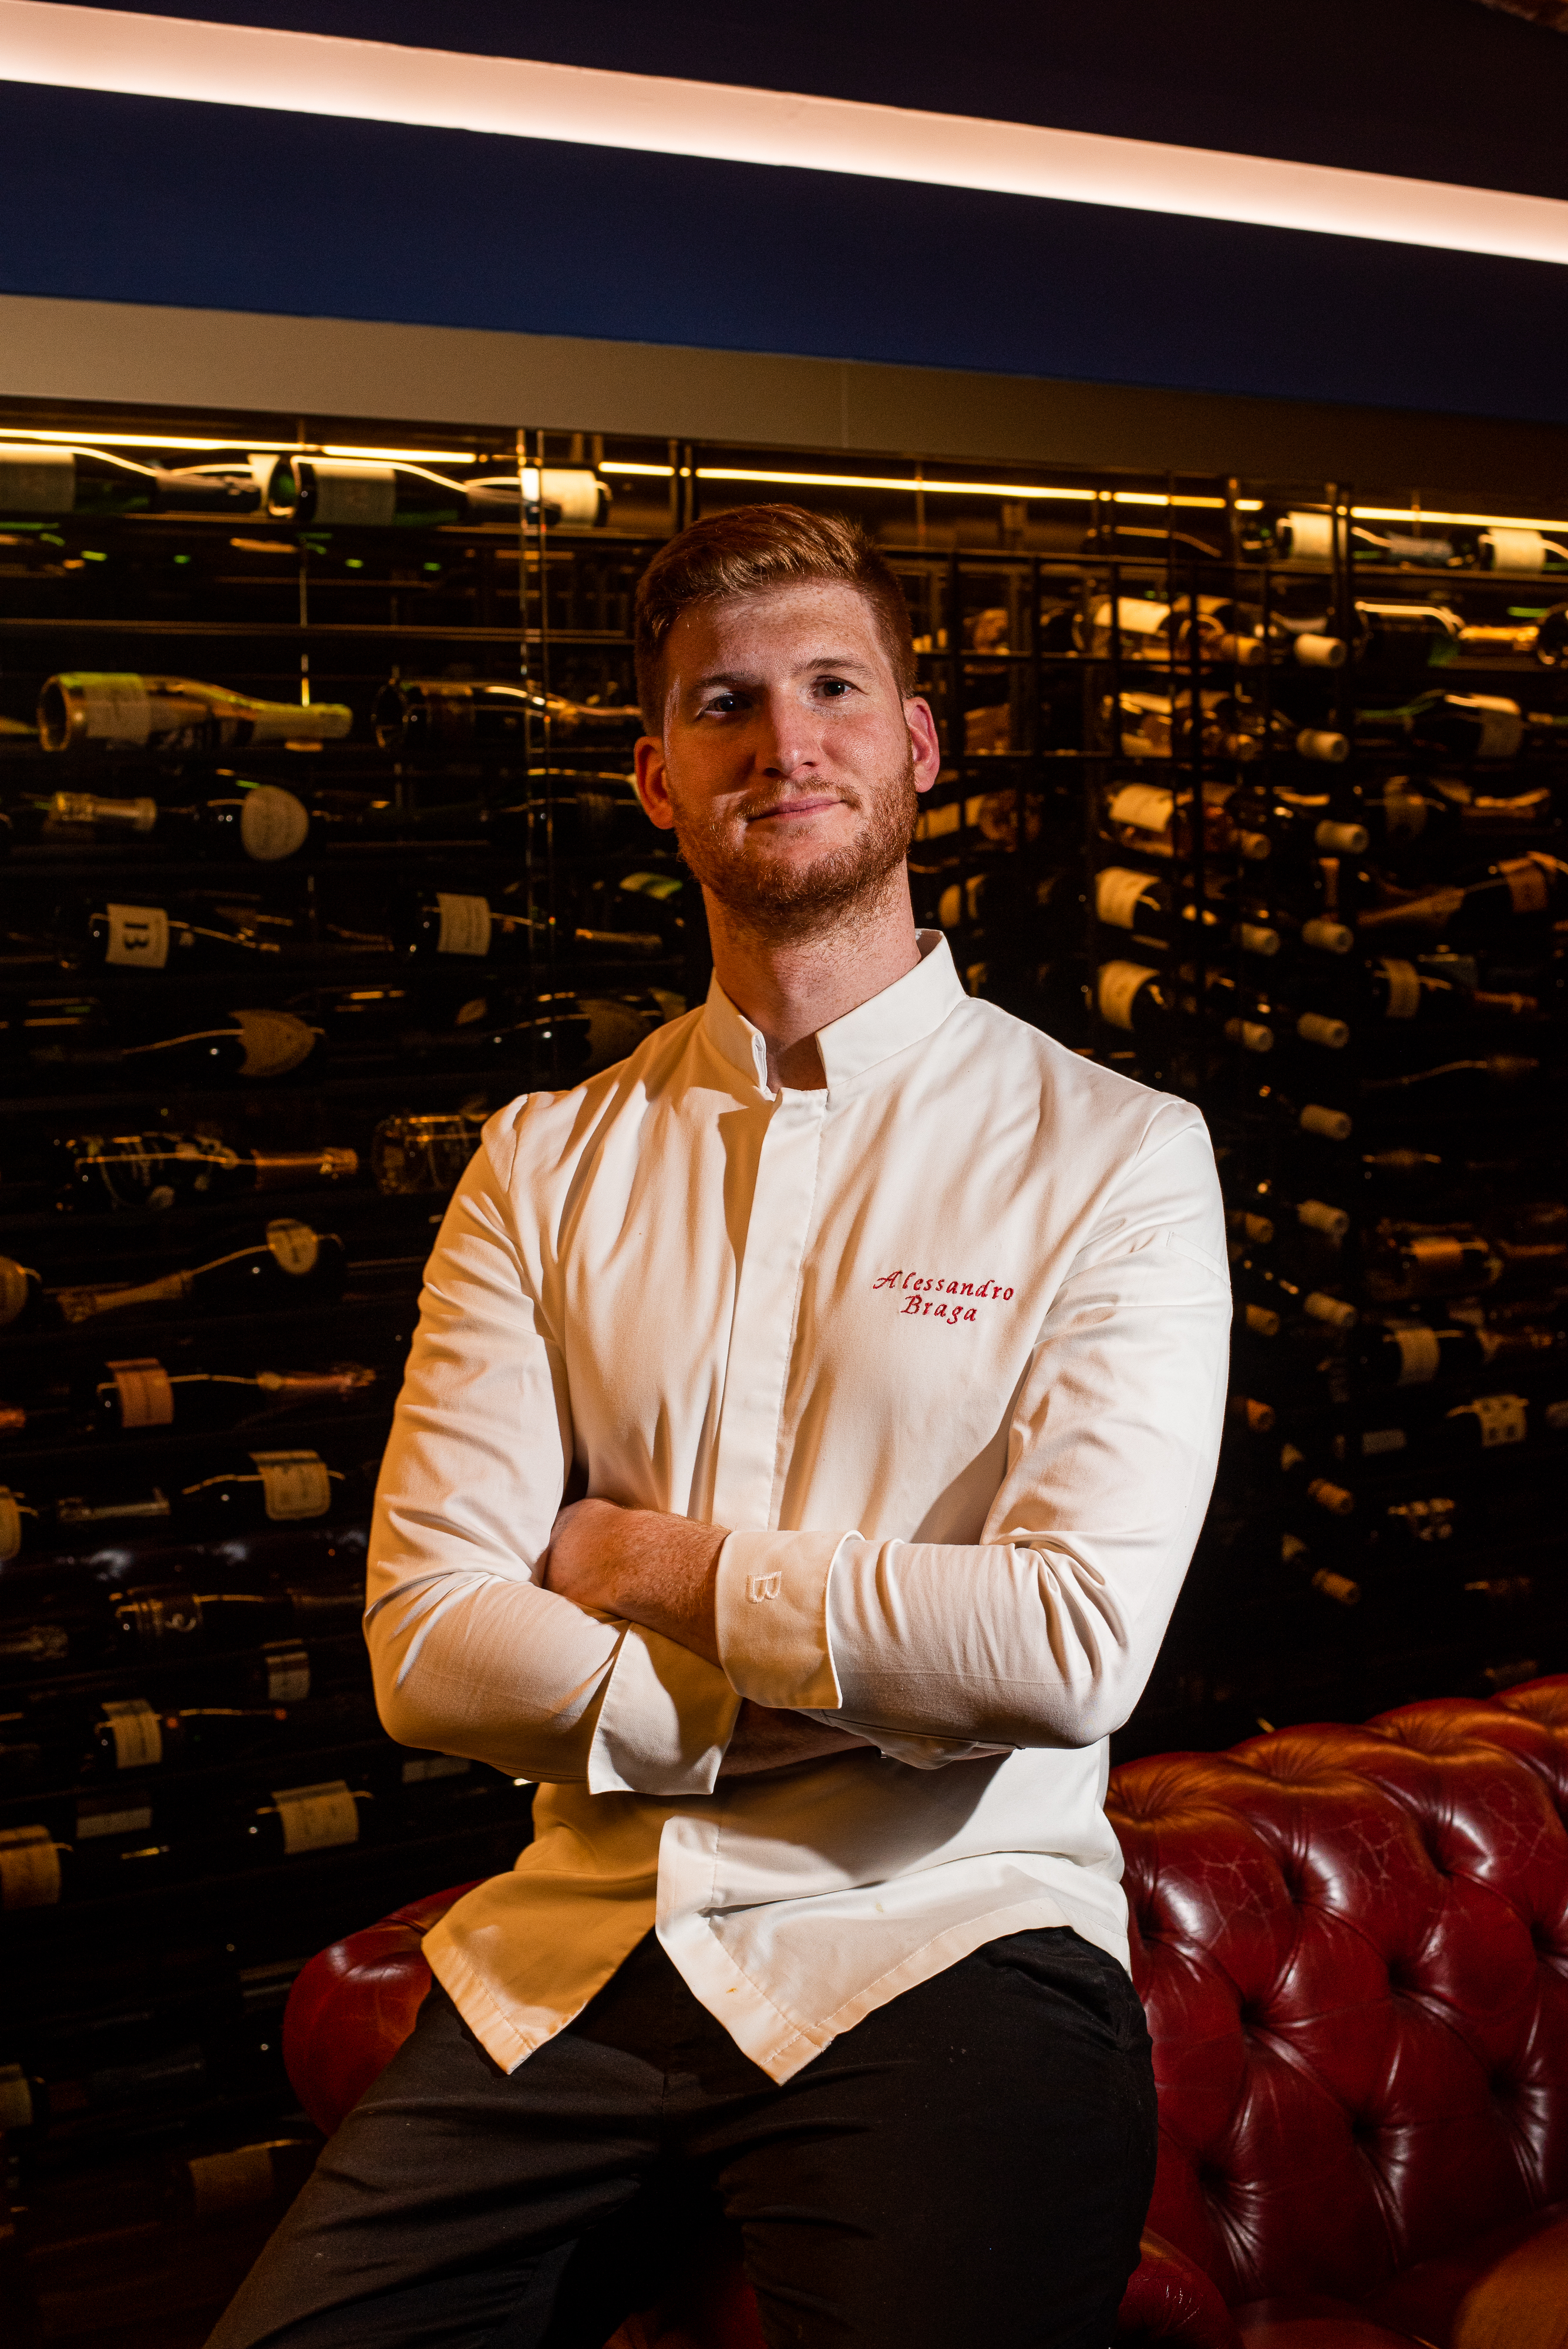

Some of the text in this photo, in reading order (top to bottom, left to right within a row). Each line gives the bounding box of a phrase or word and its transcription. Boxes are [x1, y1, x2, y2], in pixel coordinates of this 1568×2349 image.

[873, 1271, 1014, 1300] Alessandro
[900, 1295, 977, 1324] Braga
[746, 1571, 782, 1603] B
